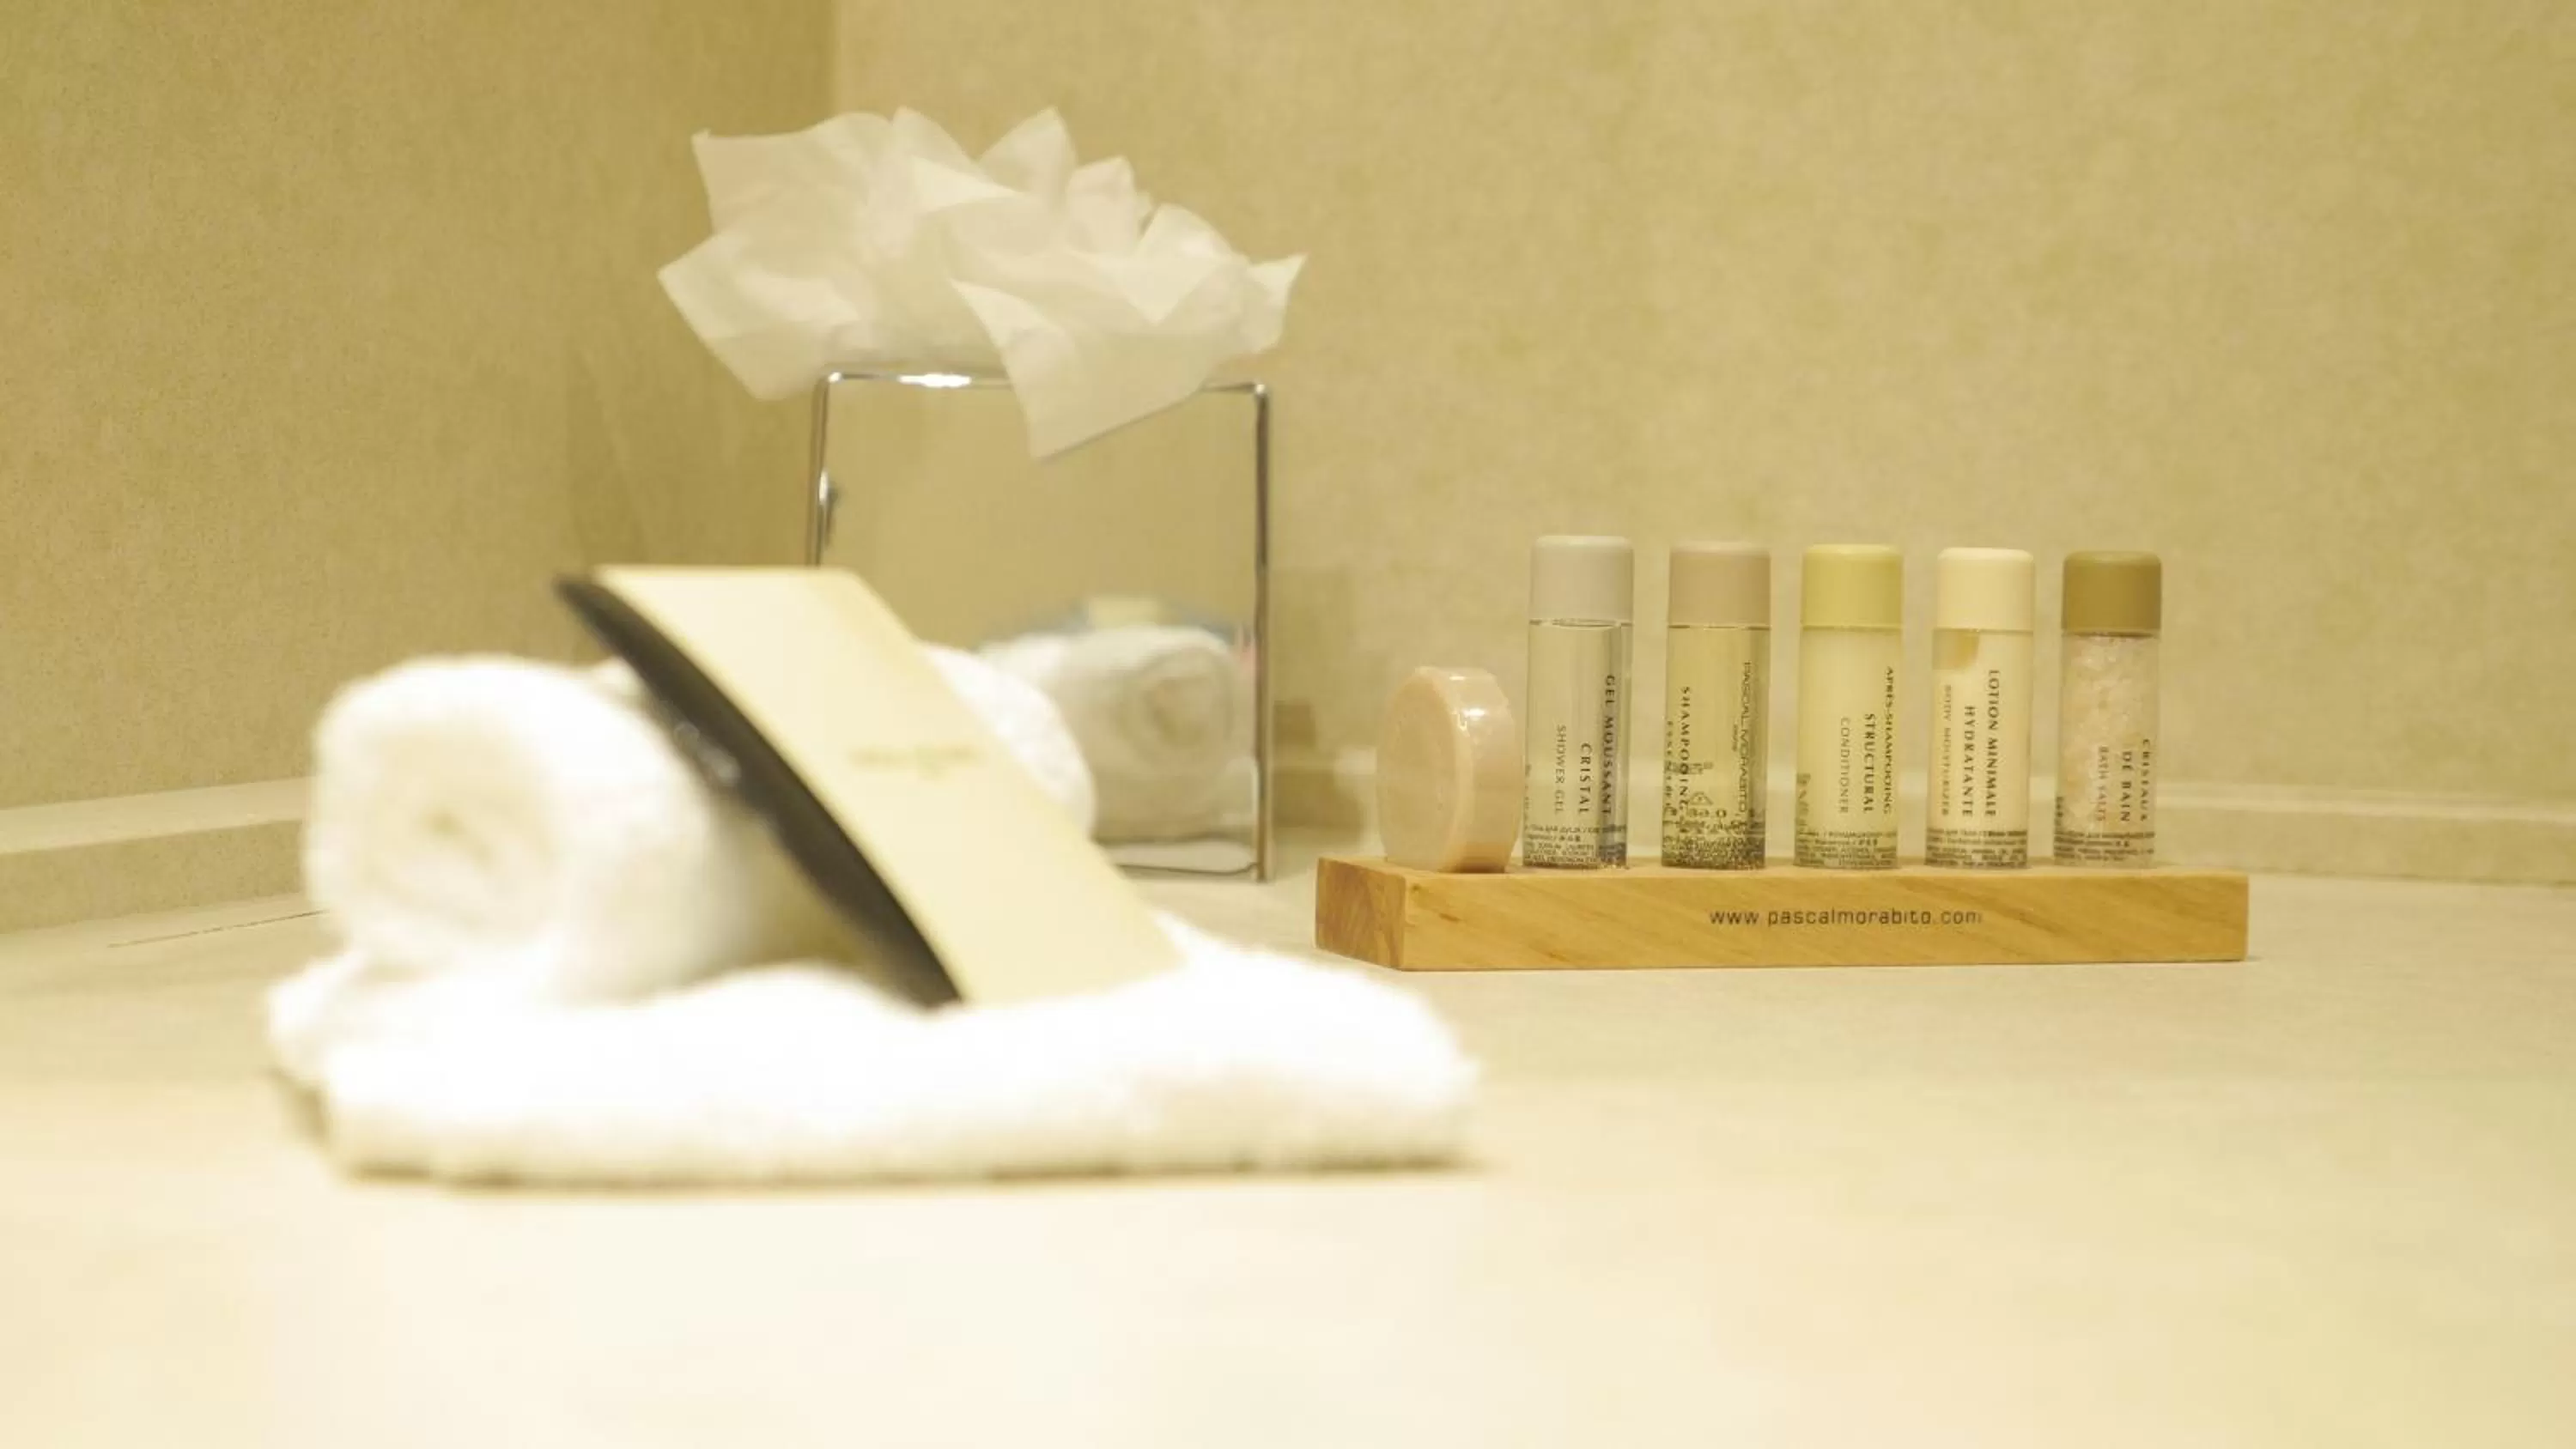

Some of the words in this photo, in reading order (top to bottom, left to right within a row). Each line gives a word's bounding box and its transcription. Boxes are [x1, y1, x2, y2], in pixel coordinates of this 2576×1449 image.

[1605, 674, 1616, 706] GEL
[1987, 669, 2000, 731] LOTION
[1555, 724, 1567, 784] SHOWER
[1578, 742, 1593, 815] CRISTAL
[1601, 715, 1614, 815] MOUSSANT
[1679, 686, 1691, 810] SHAMPOOING
[1838, 716, 1850, 814] CONDITIONER
[1863, 713, 1876, 815] STRUCTURAL
[1961, 705, 1976, 817] HYDRATANTE
[1985, 737, 1999, 816] MINIMALE
[1554, 789, 1565, 815] GEL
[2120, 780, 2132, 822] BAIN
